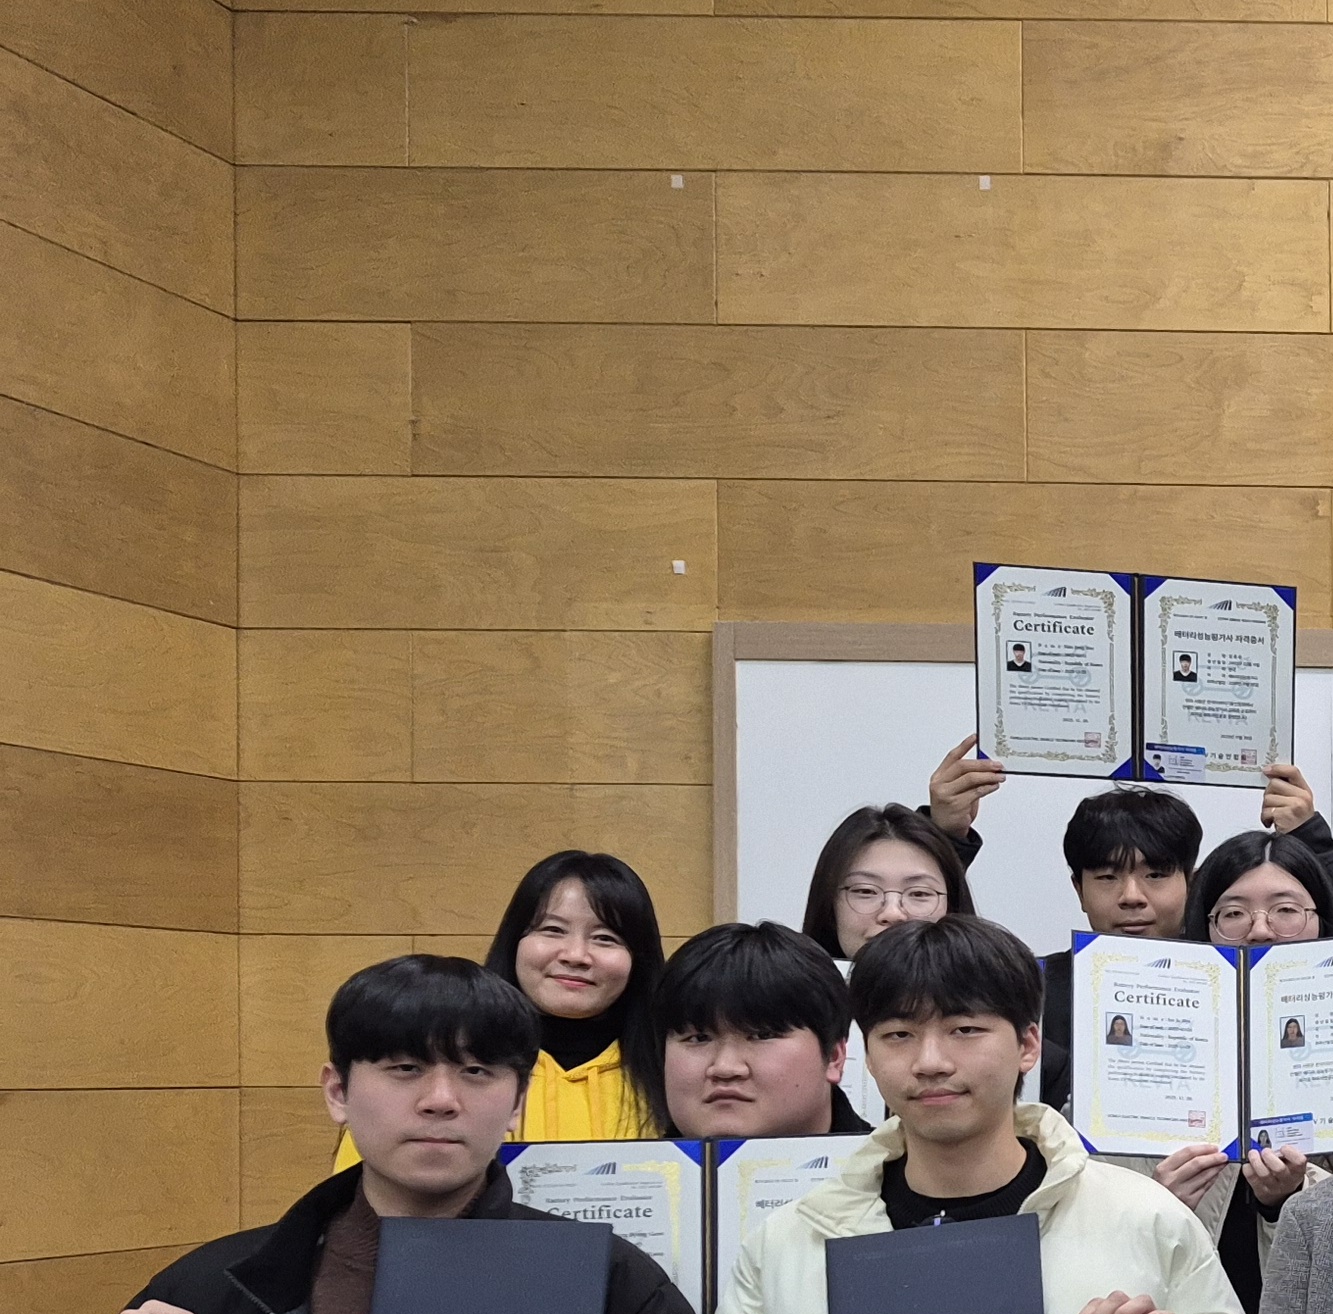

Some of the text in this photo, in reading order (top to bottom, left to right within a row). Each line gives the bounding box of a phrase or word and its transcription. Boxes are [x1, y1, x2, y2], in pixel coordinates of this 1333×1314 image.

[1013, 620, 1095, 635] Certificate
[1114, 990, 1200, 1008] Certificate
[547, 1205, 653, 1220] Certificate
